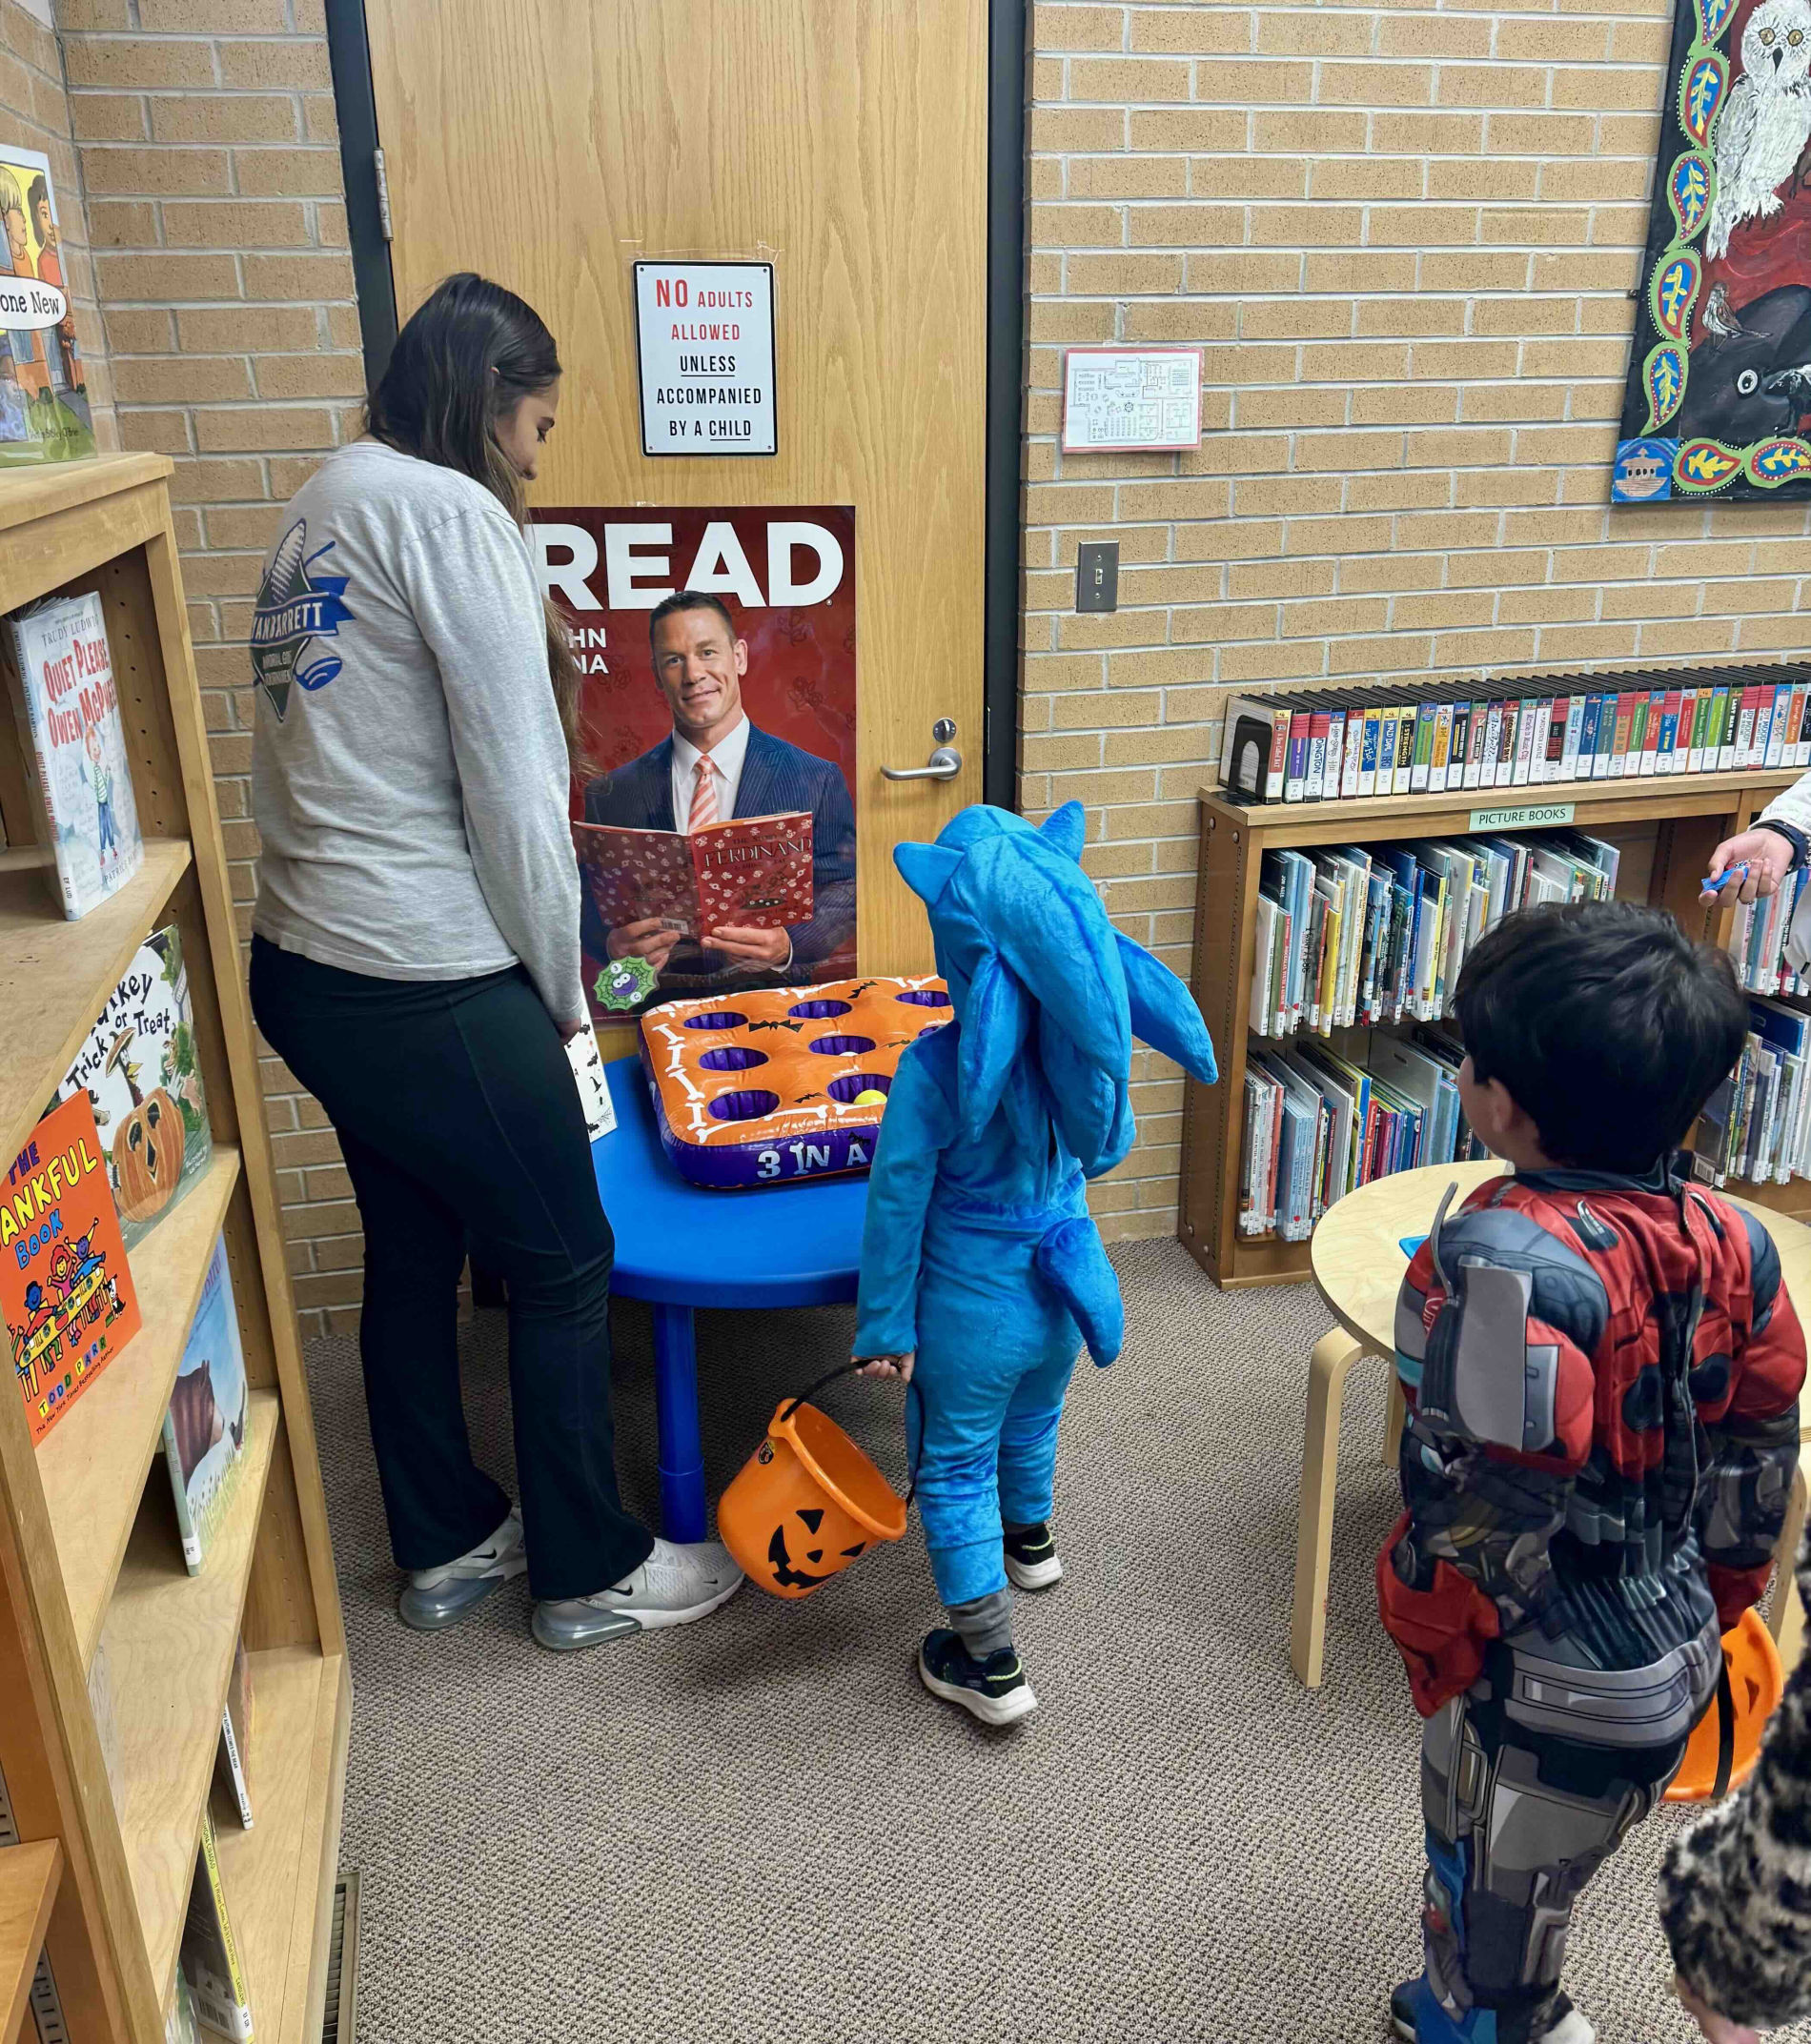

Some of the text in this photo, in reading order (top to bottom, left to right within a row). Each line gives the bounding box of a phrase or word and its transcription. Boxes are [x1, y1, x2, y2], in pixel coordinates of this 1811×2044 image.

[30, 292, 59, 315] New
[656, 279, 753, 308] NO ADULTS
[671, 324, 740, 340] ALLOWED
[680, 355, 736, 372] UNLESS
[657, 388, 762, 404] ACCOMPANIED
[669, 420, 751, 436] BY A CHILD
[527, 522, 844, 611] READ
[42, 624, 69, 647] TRUDY
[71, 615, 100, 636] LUDWIG
[43, 655, 77, 705] QUIET
[48, 707, 83, 748] OWEN
[1313, 738, 1325, 774] DINGTON
[1400, 728, 1410, 765] STRENGTH
[1479, 808, 1566, 824] PICTURE BOOKS
[705, 837, 811, 867] FERDINAND
[65, 1008, 171, 1088] Trick or Treat
[9, 1141, 40, 1185] THE
[757, 1142, 868, 1179] 3 IN A
[14, 1207, 63, 1270] BOOK
[39, 1336, 107, 1414] TODD PARR
[36, 1424, 46, 1434] The
[46, 1413, 56, 1424] New
[56, 1401, 67, 1413] York
